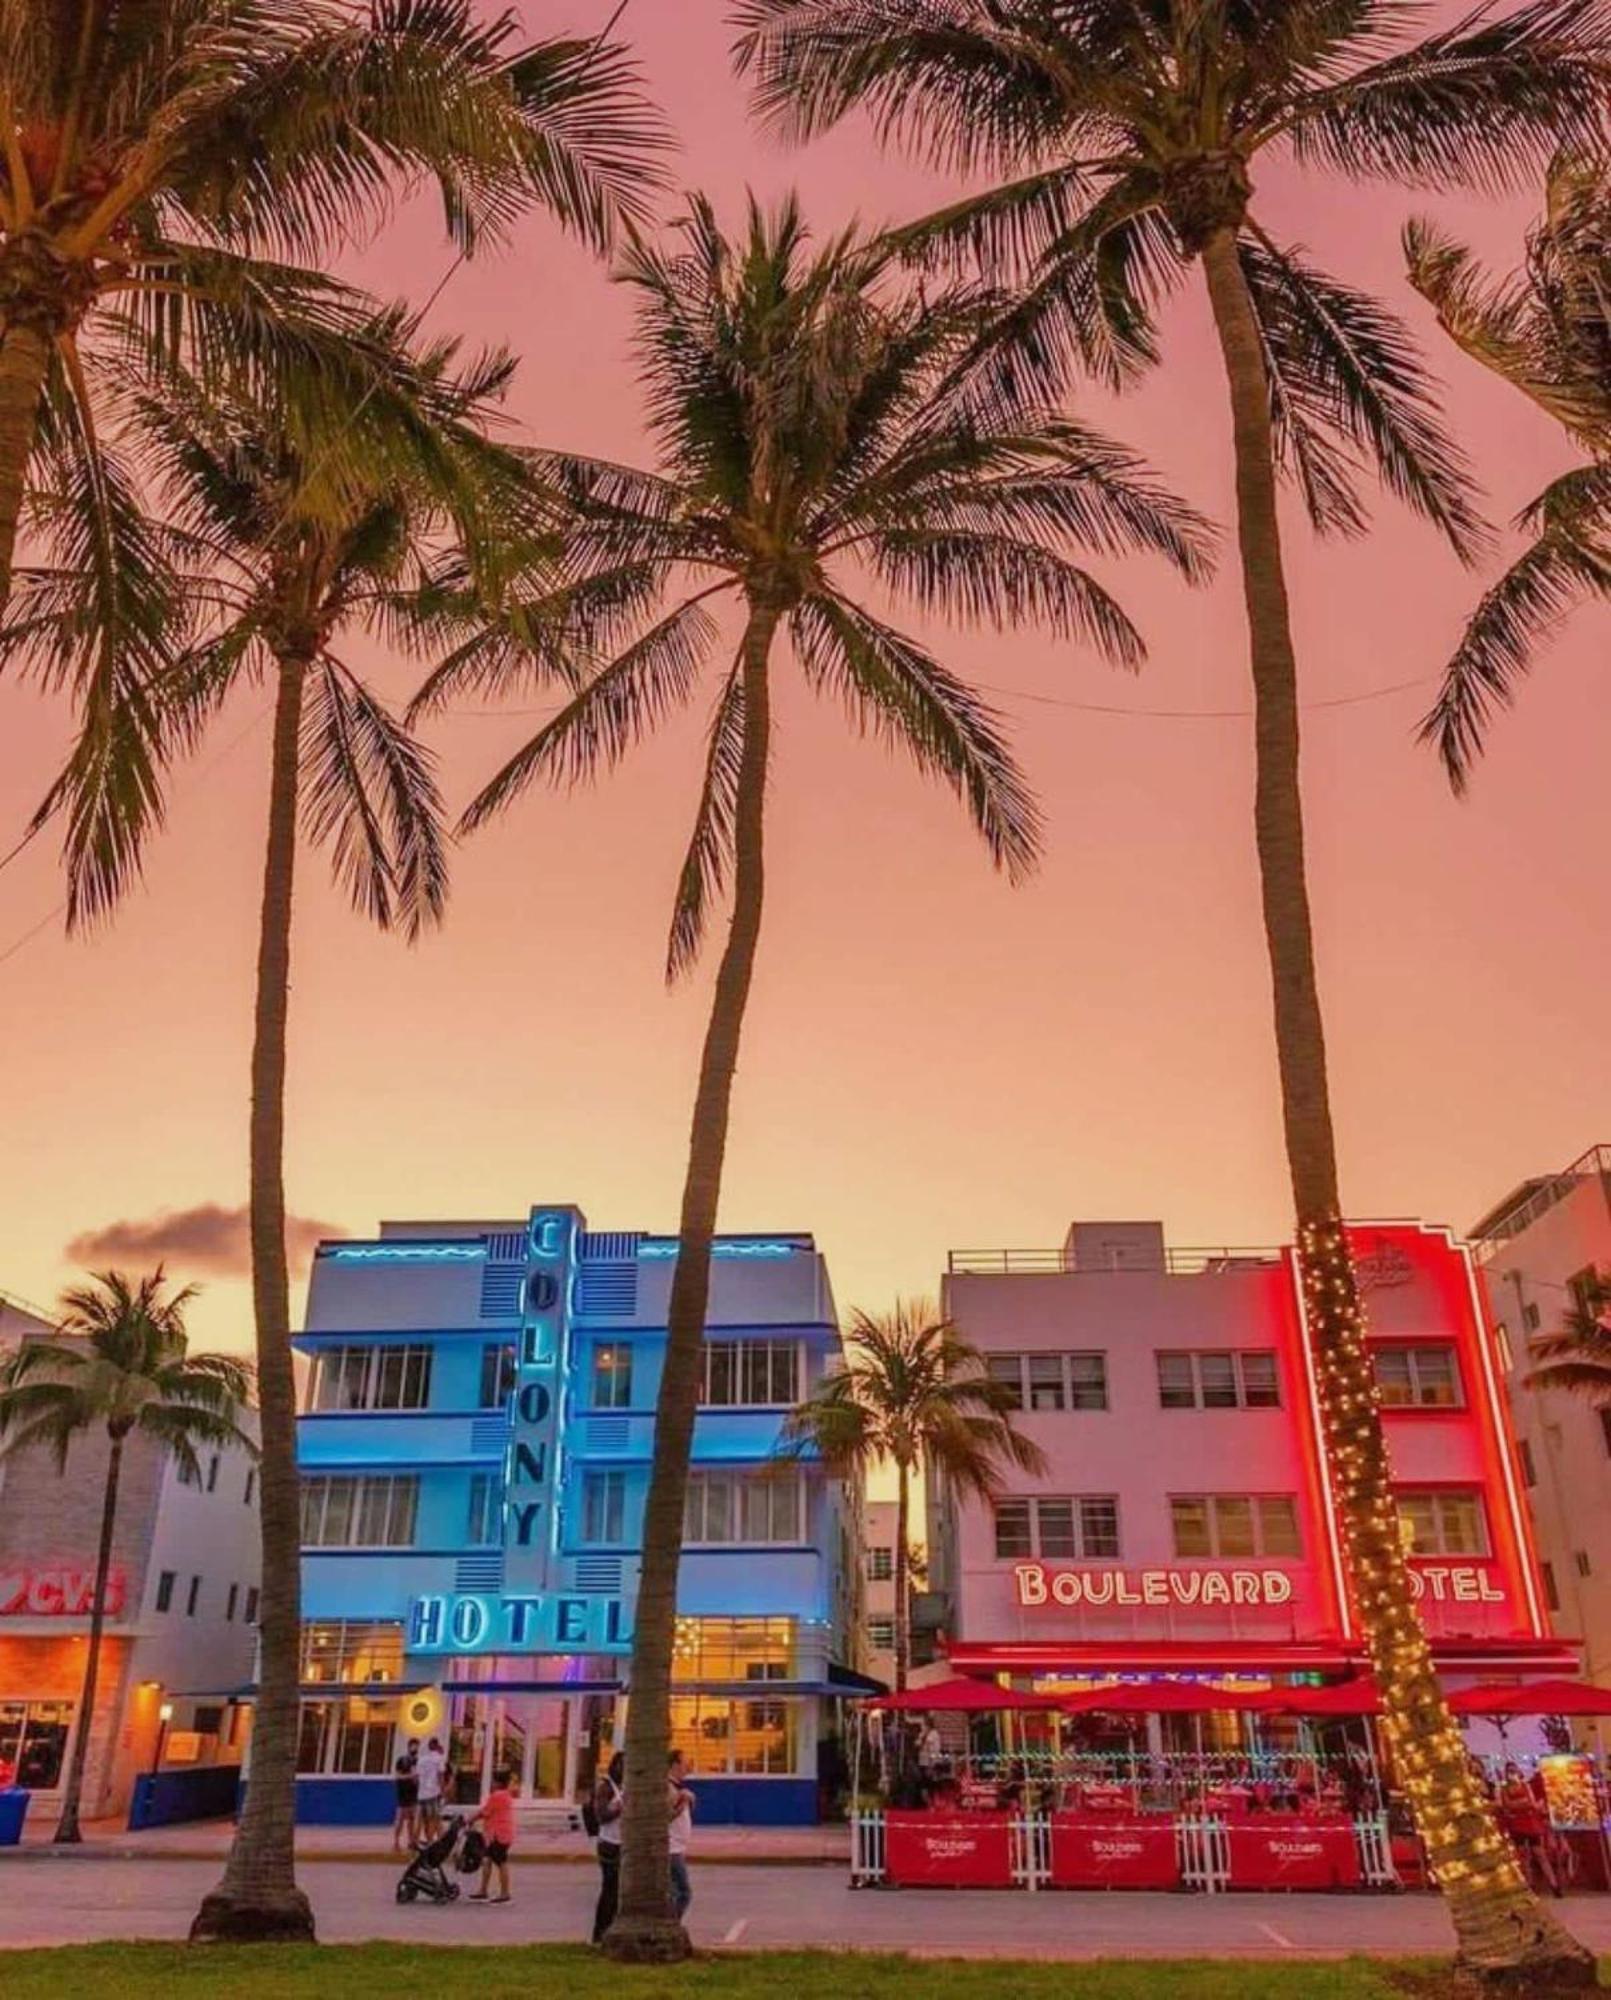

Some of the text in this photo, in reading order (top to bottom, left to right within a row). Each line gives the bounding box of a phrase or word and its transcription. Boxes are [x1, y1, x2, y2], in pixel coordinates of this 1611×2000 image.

[512, 1213, 563, 1547] COLONY
[1015, 1565, 1505, 1604] BOULEVARD OTEL
[411, 1595, 634, 1648] HOTEL
